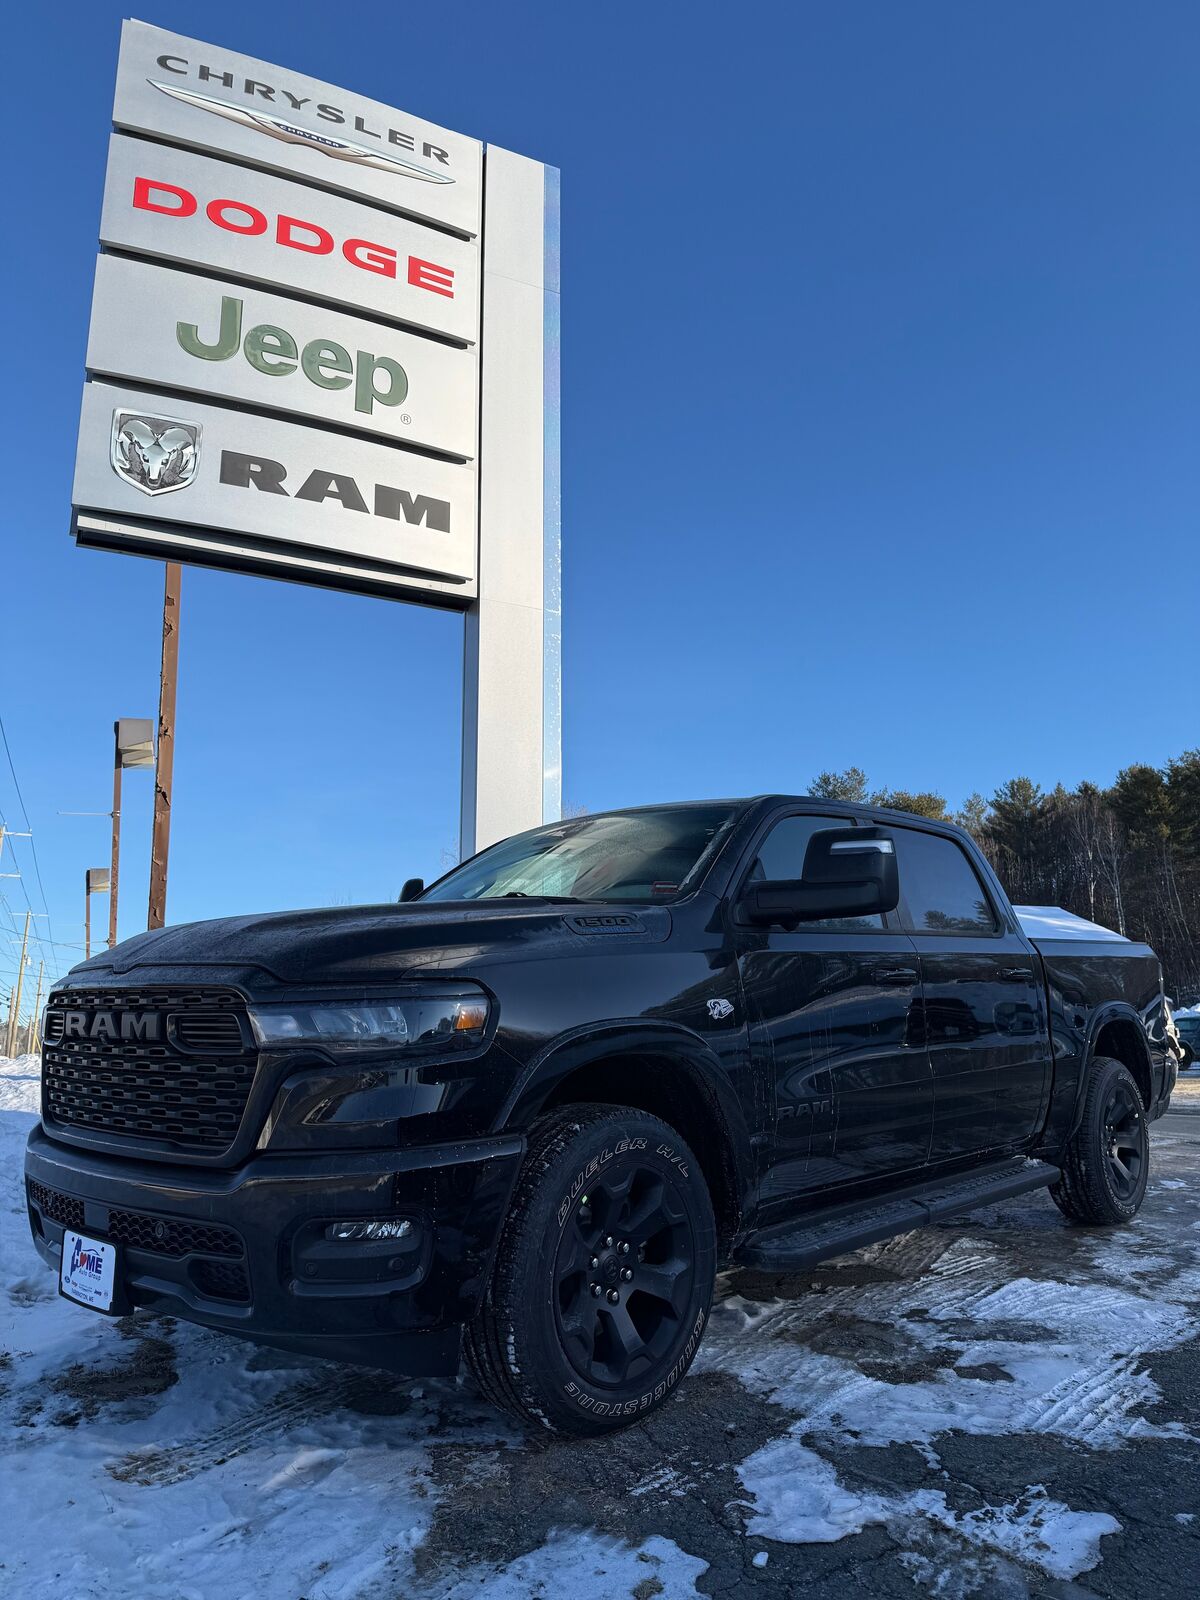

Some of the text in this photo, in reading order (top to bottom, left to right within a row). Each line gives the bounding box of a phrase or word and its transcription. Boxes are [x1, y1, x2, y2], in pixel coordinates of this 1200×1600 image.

[156, 54, 450, 166] CHRYSLER
[280, 124, 340, 147] CHRYSLER
[132, 176, 455, 299] DODGE
[176, 295, 409, 415] Jeep
[219, 449, 451, 534] RAM
[575, 916, 631, 927] 1500
[65, 1011, 161, 1041] RAM
[556, 1137, 648, 1228] DUELER
